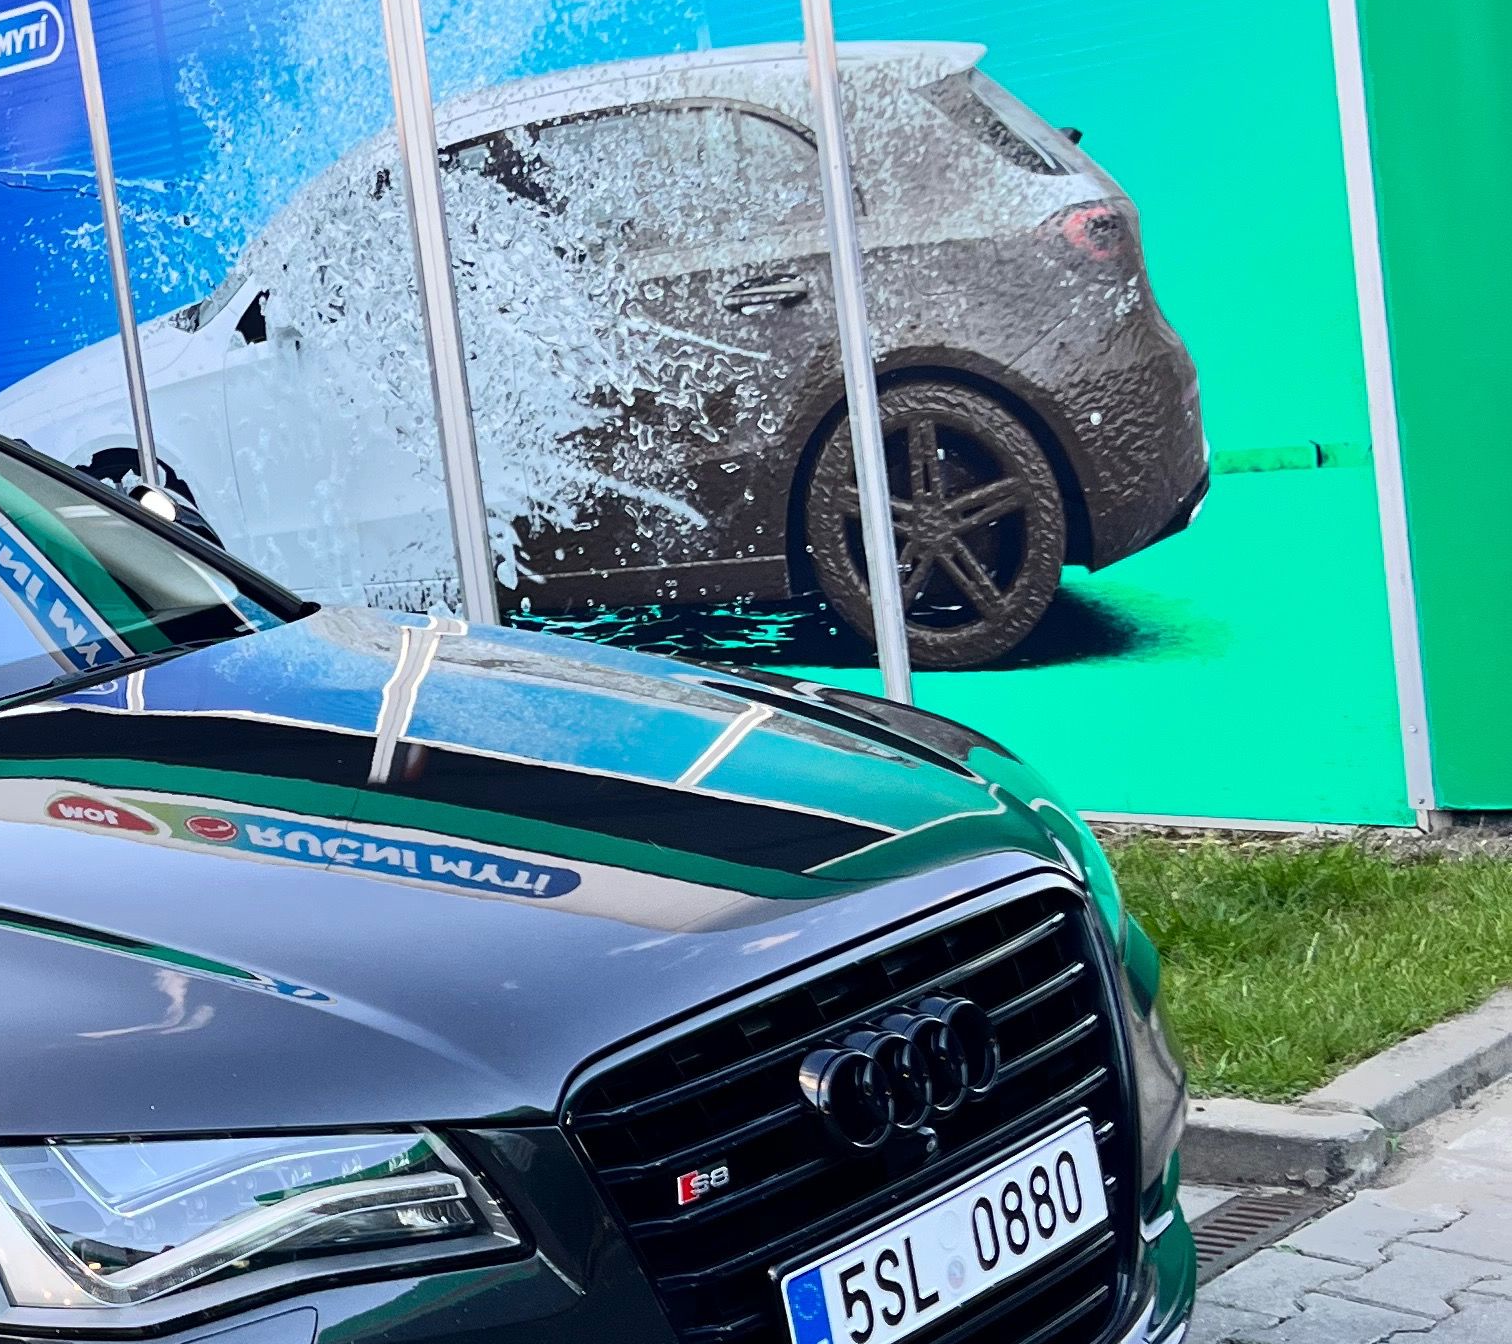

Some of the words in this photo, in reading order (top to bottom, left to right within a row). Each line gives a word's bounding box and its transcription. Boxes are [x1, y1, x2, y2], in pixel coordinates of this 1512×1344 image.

[690, 1166, 729, 1195] S8
[839, 1236, 939, 1344] 5SL
[971, 1150, 1083, 1271] 0880
